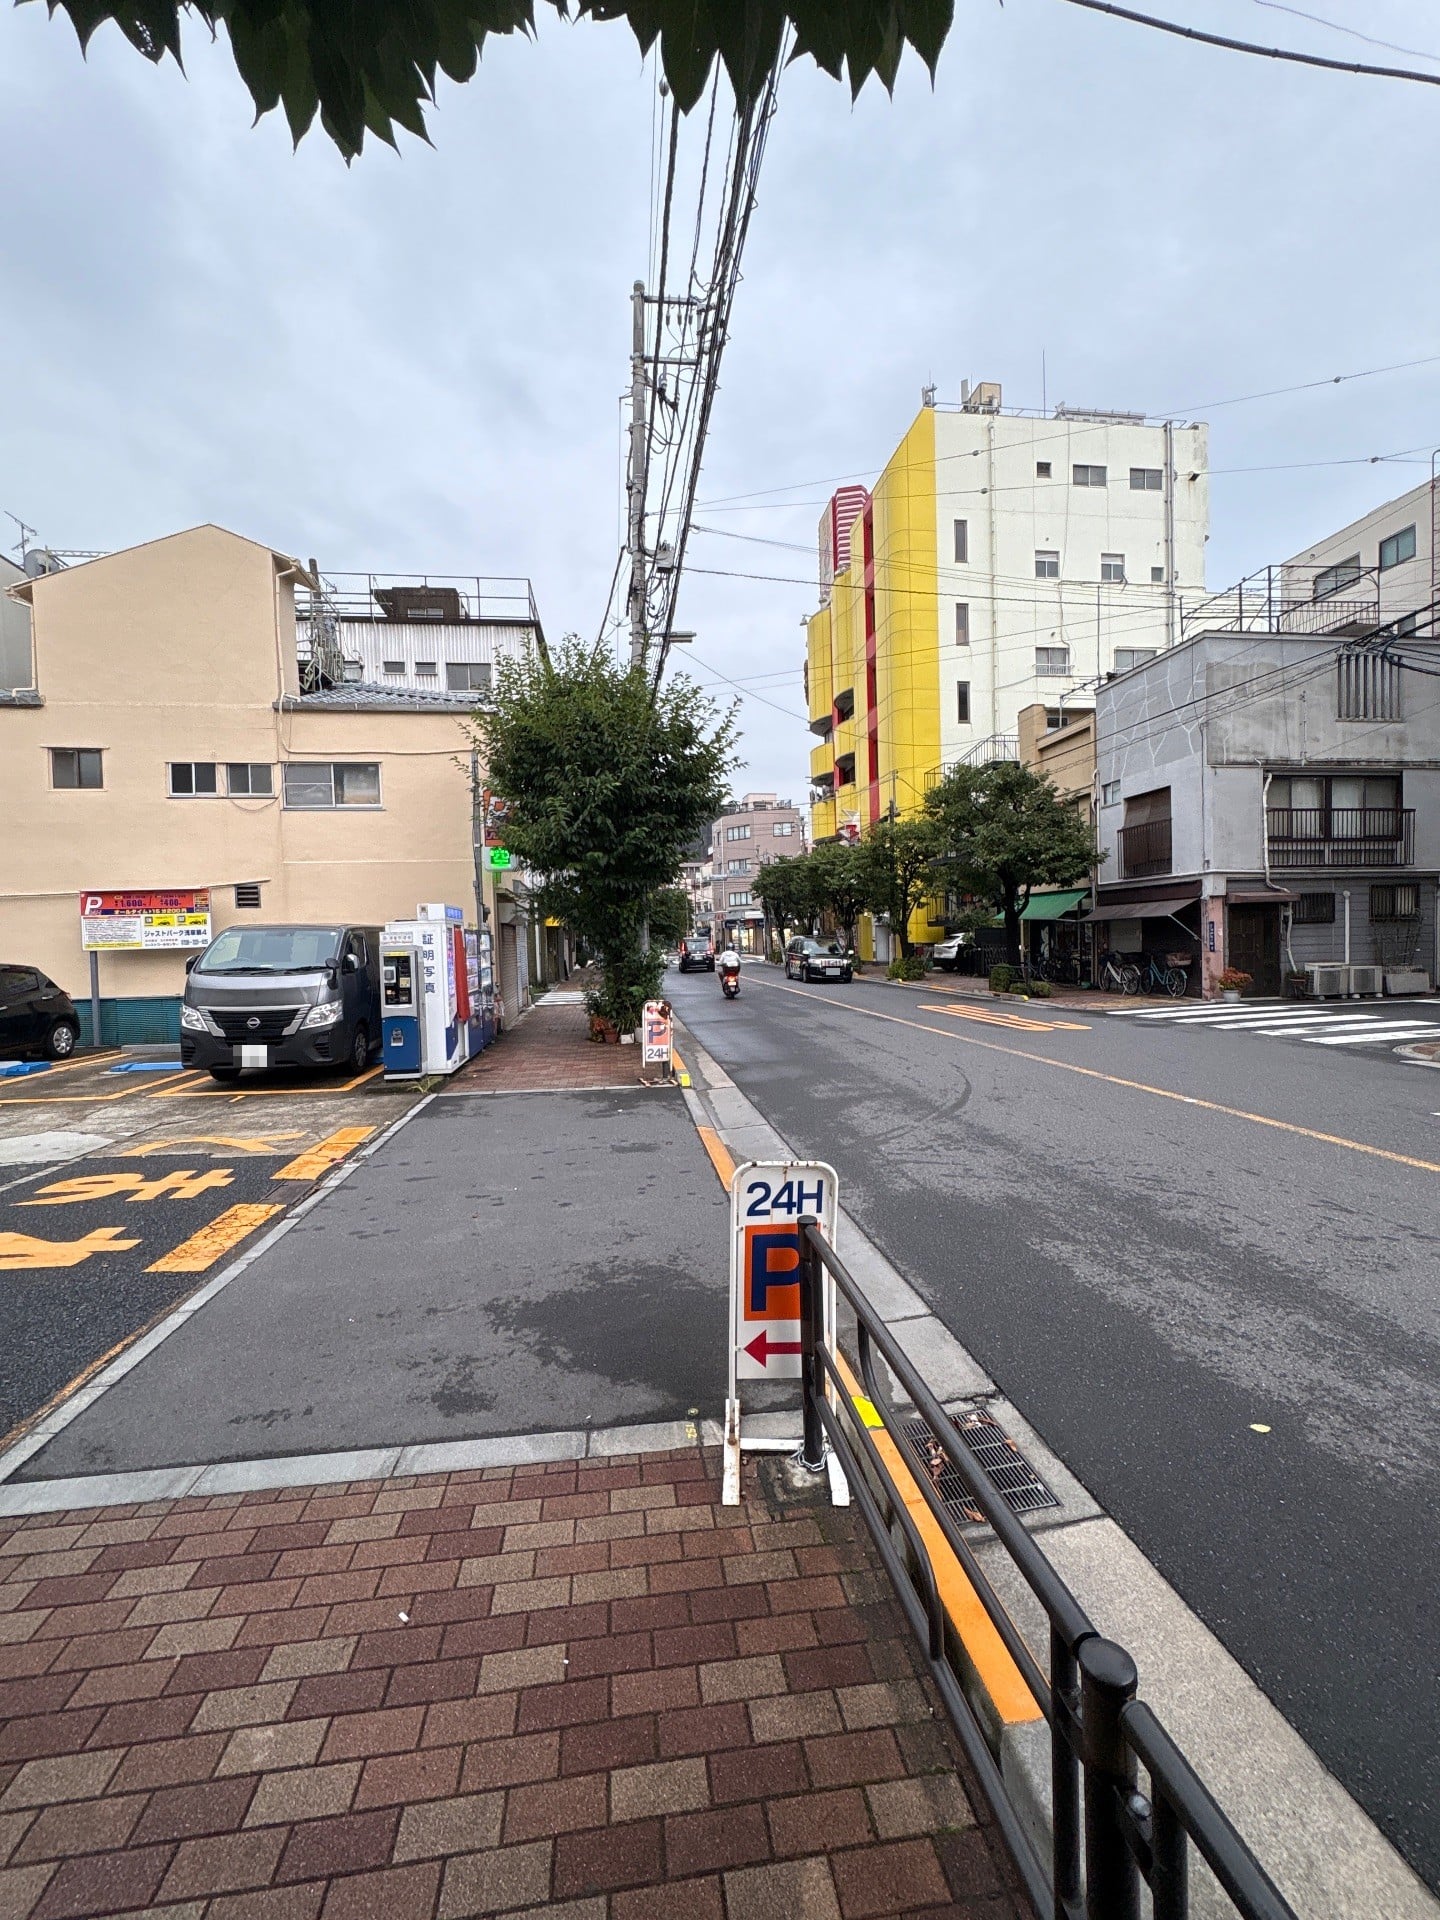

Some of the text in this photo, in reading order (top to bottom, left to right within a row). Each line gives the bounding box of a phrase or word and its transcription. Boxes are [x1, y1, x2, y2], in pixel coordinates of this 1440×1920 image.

[85, 896, 103, 915] P
[422, 933, 436, 994] 証明写真
[648, 1020, 667, 1044] P
[647, 1047, 669, 1060] 24H
[746, 1179, 824, 1217] 24H
[751, 1233, 801, 1312] P
